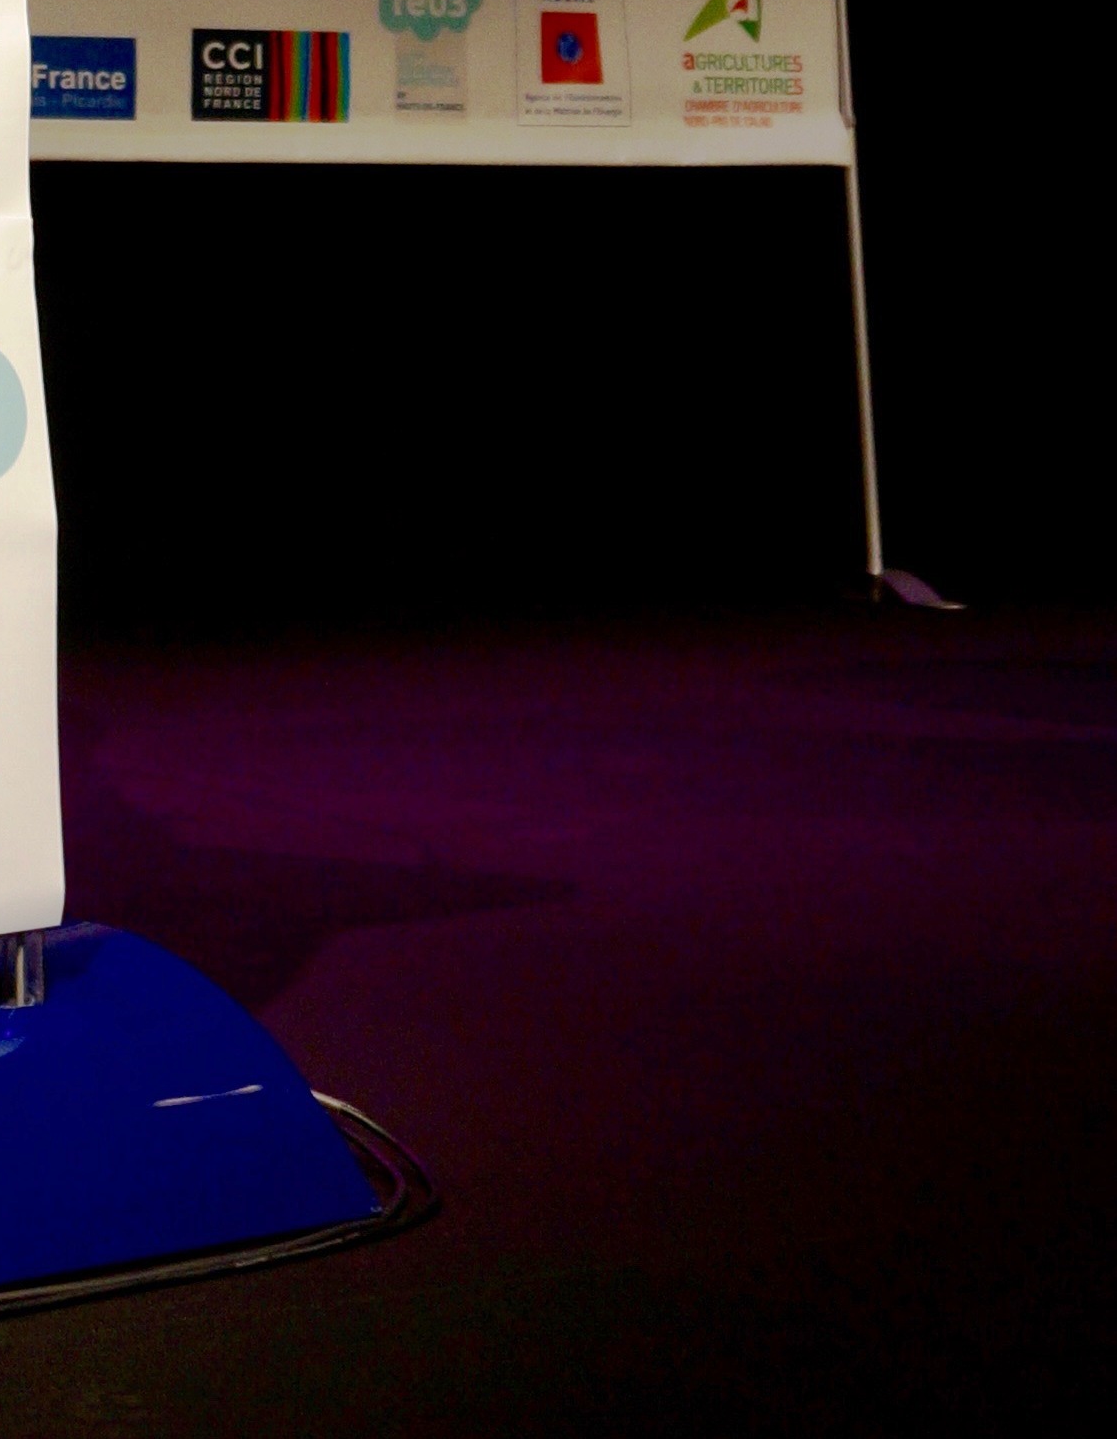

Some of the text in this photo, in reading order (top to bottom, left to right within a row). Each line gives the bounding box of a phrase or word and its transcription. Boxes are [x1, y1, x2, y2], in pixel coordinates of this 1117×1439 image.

[201, 39, 265, 71] CCI
[31, 62, 127, 92] France
[704, 76, 805, 96] TERRITOIRES
[202, 85, 262, 98] NORD DE
[202, 97, 262, 111] FRANCE
